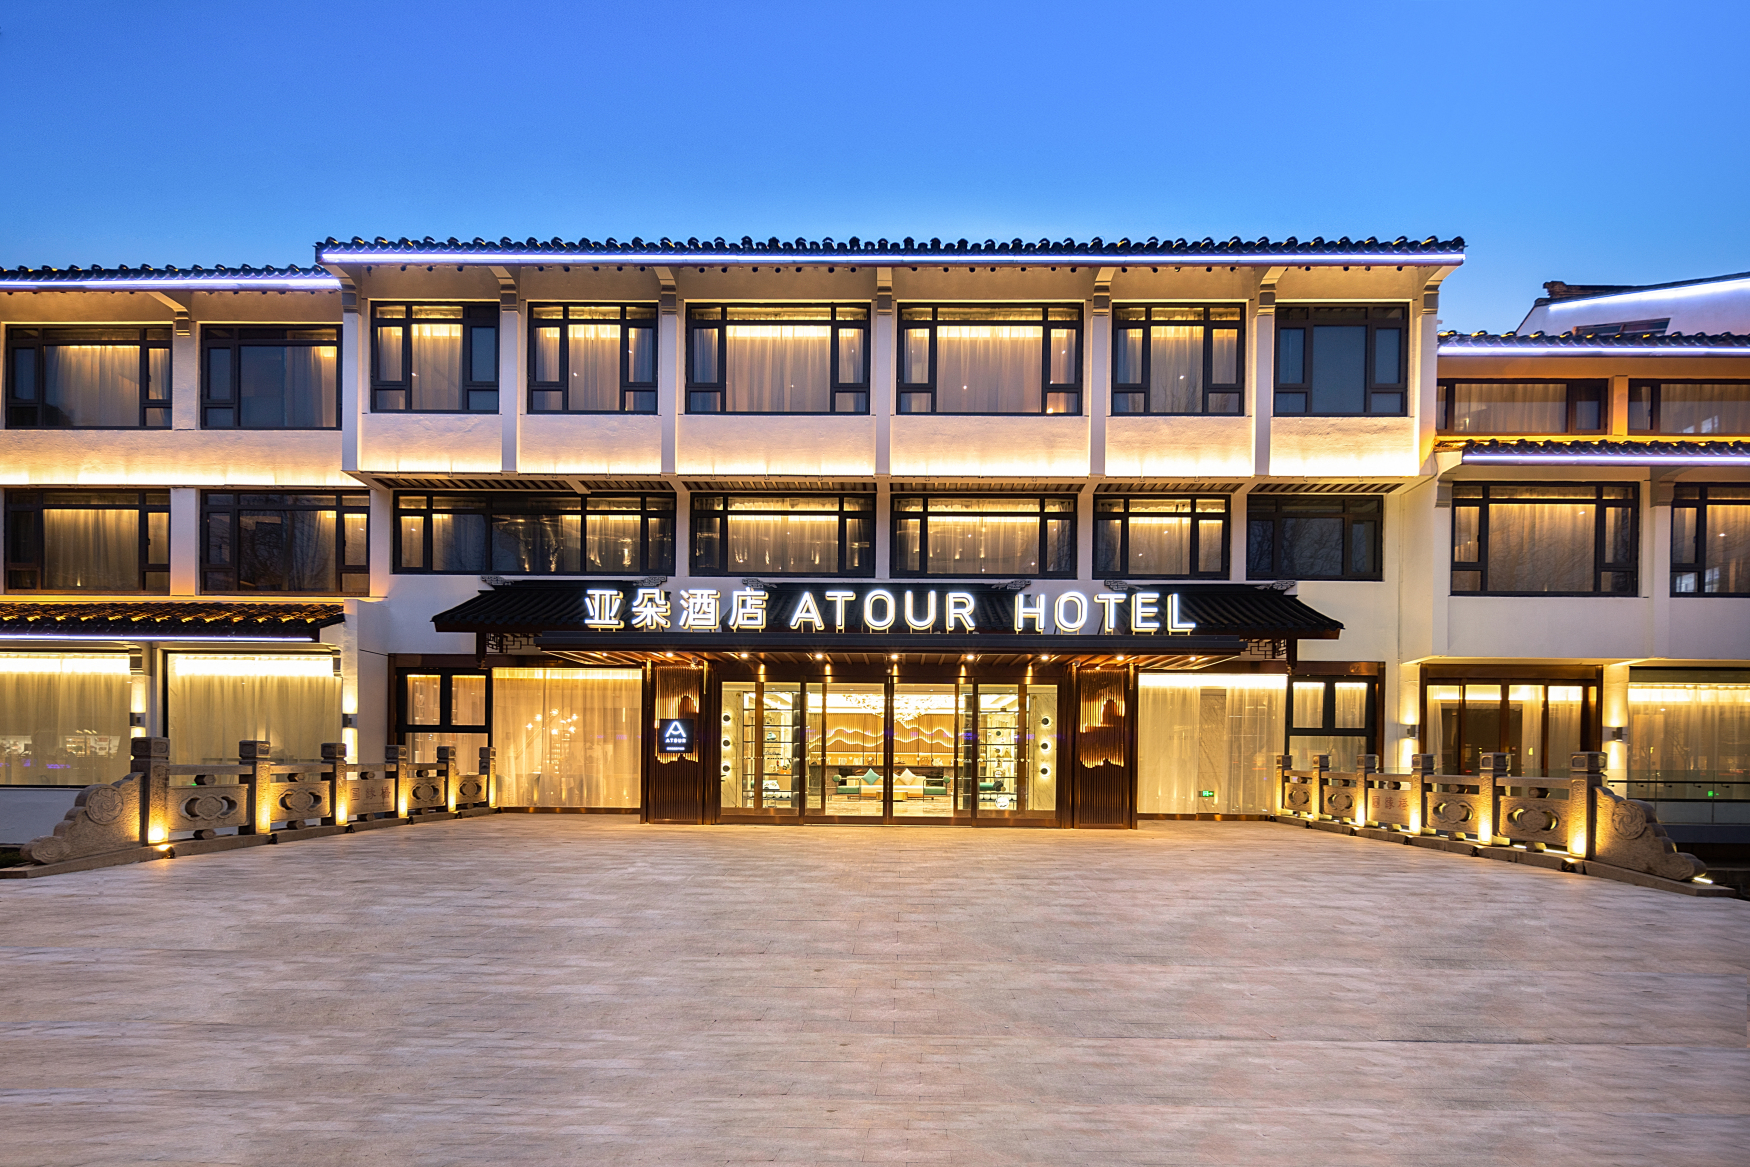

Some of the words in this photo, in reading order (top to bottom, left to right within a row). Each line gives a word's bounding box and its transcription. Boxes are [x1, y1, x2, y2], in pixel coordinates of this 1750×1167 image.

[584, 587, 768, 629] 亚朵酒店
[790, 589, 976, 631] ATOUR
[1014, 591, 1196, 632] HOTEL
